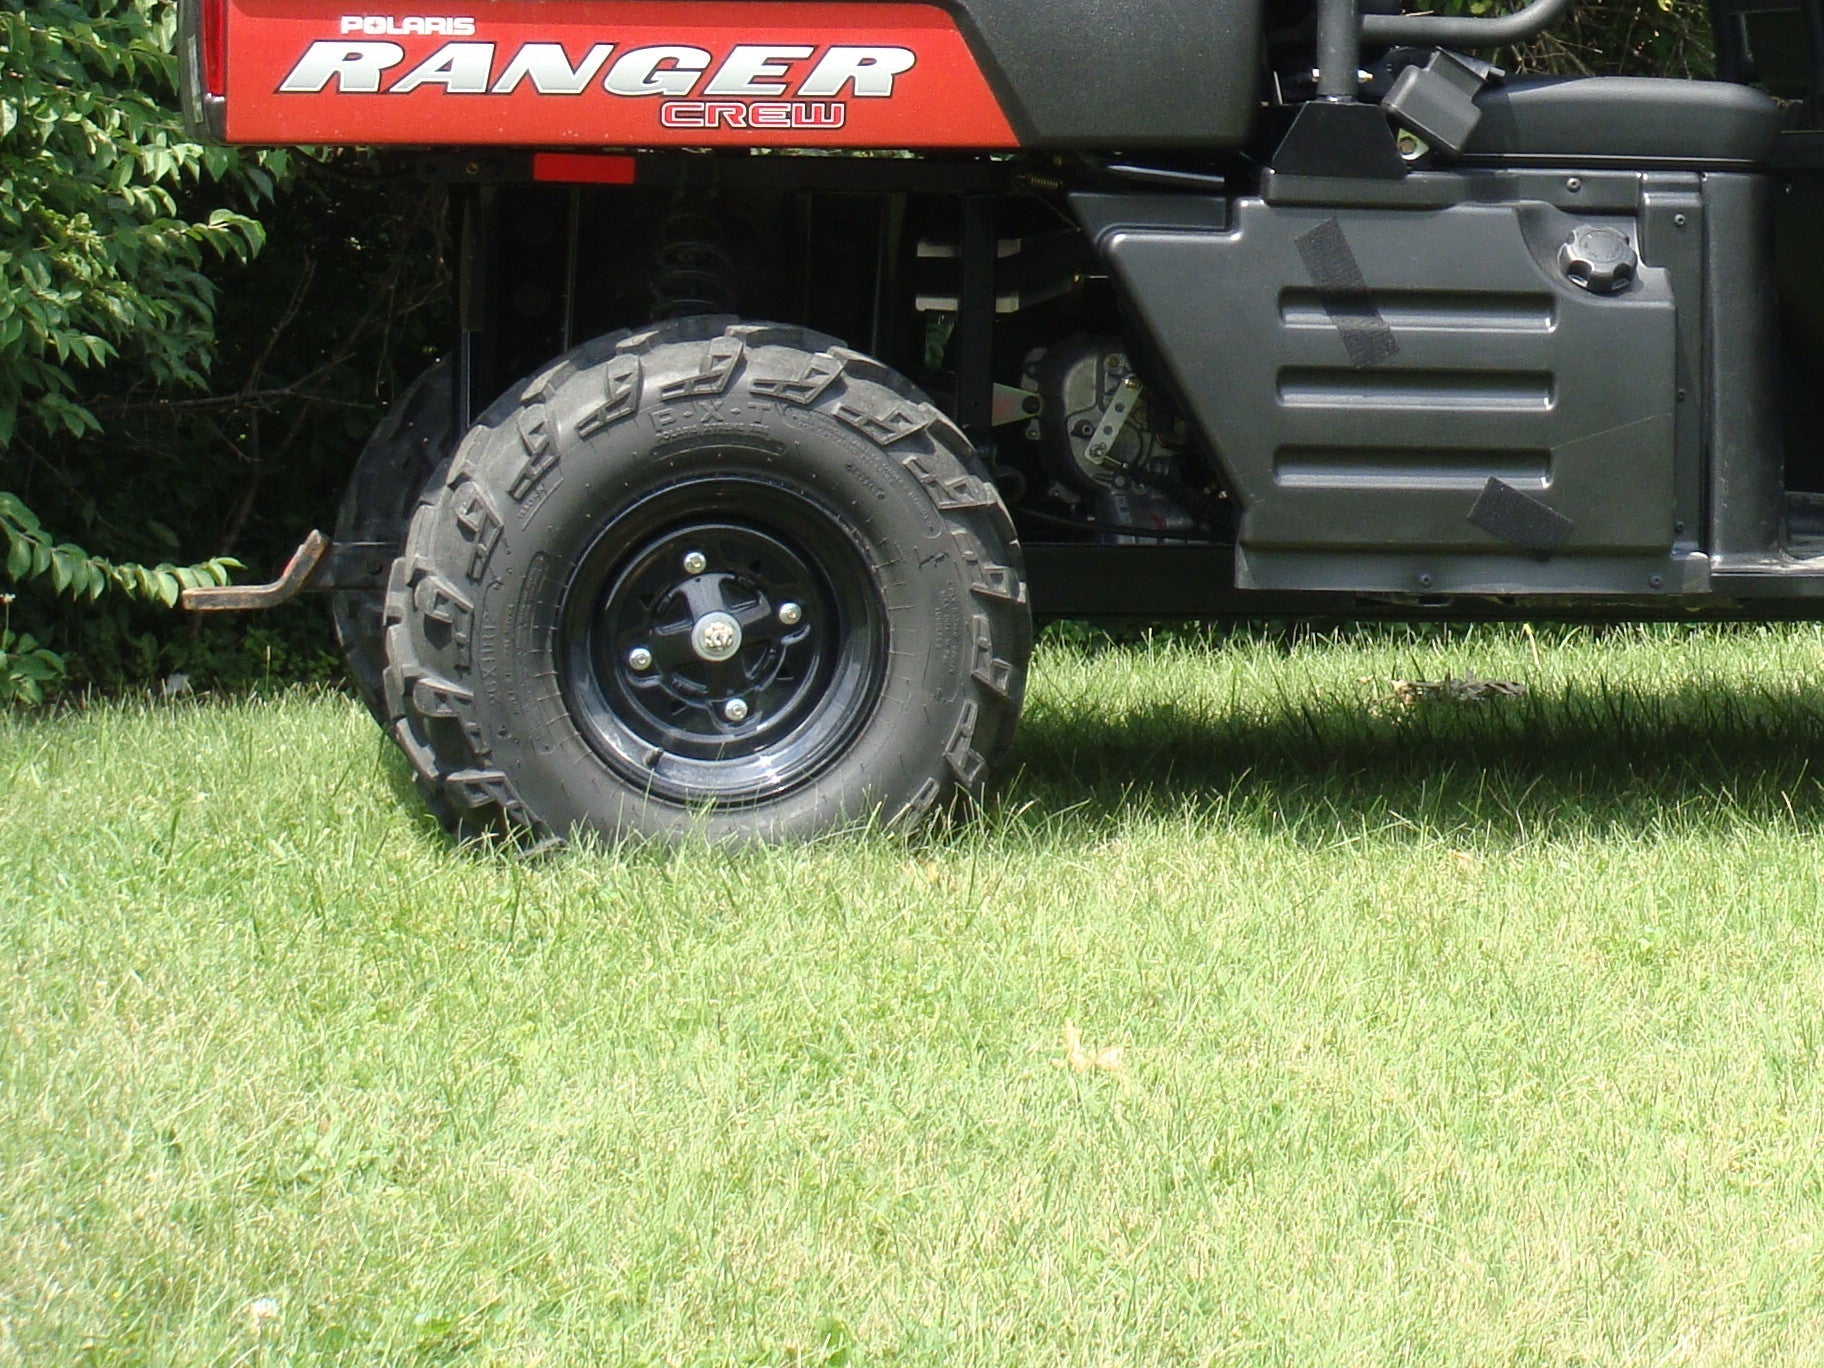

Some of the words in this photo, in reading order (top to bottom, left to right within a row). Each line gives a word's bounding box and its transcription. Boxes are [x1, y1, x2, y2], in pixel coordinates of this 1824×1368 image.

[340, 15, 476, 36] POLARIS
[273, 39, 918, 98] RANGER
[660, 101, 847, 130] CREW
